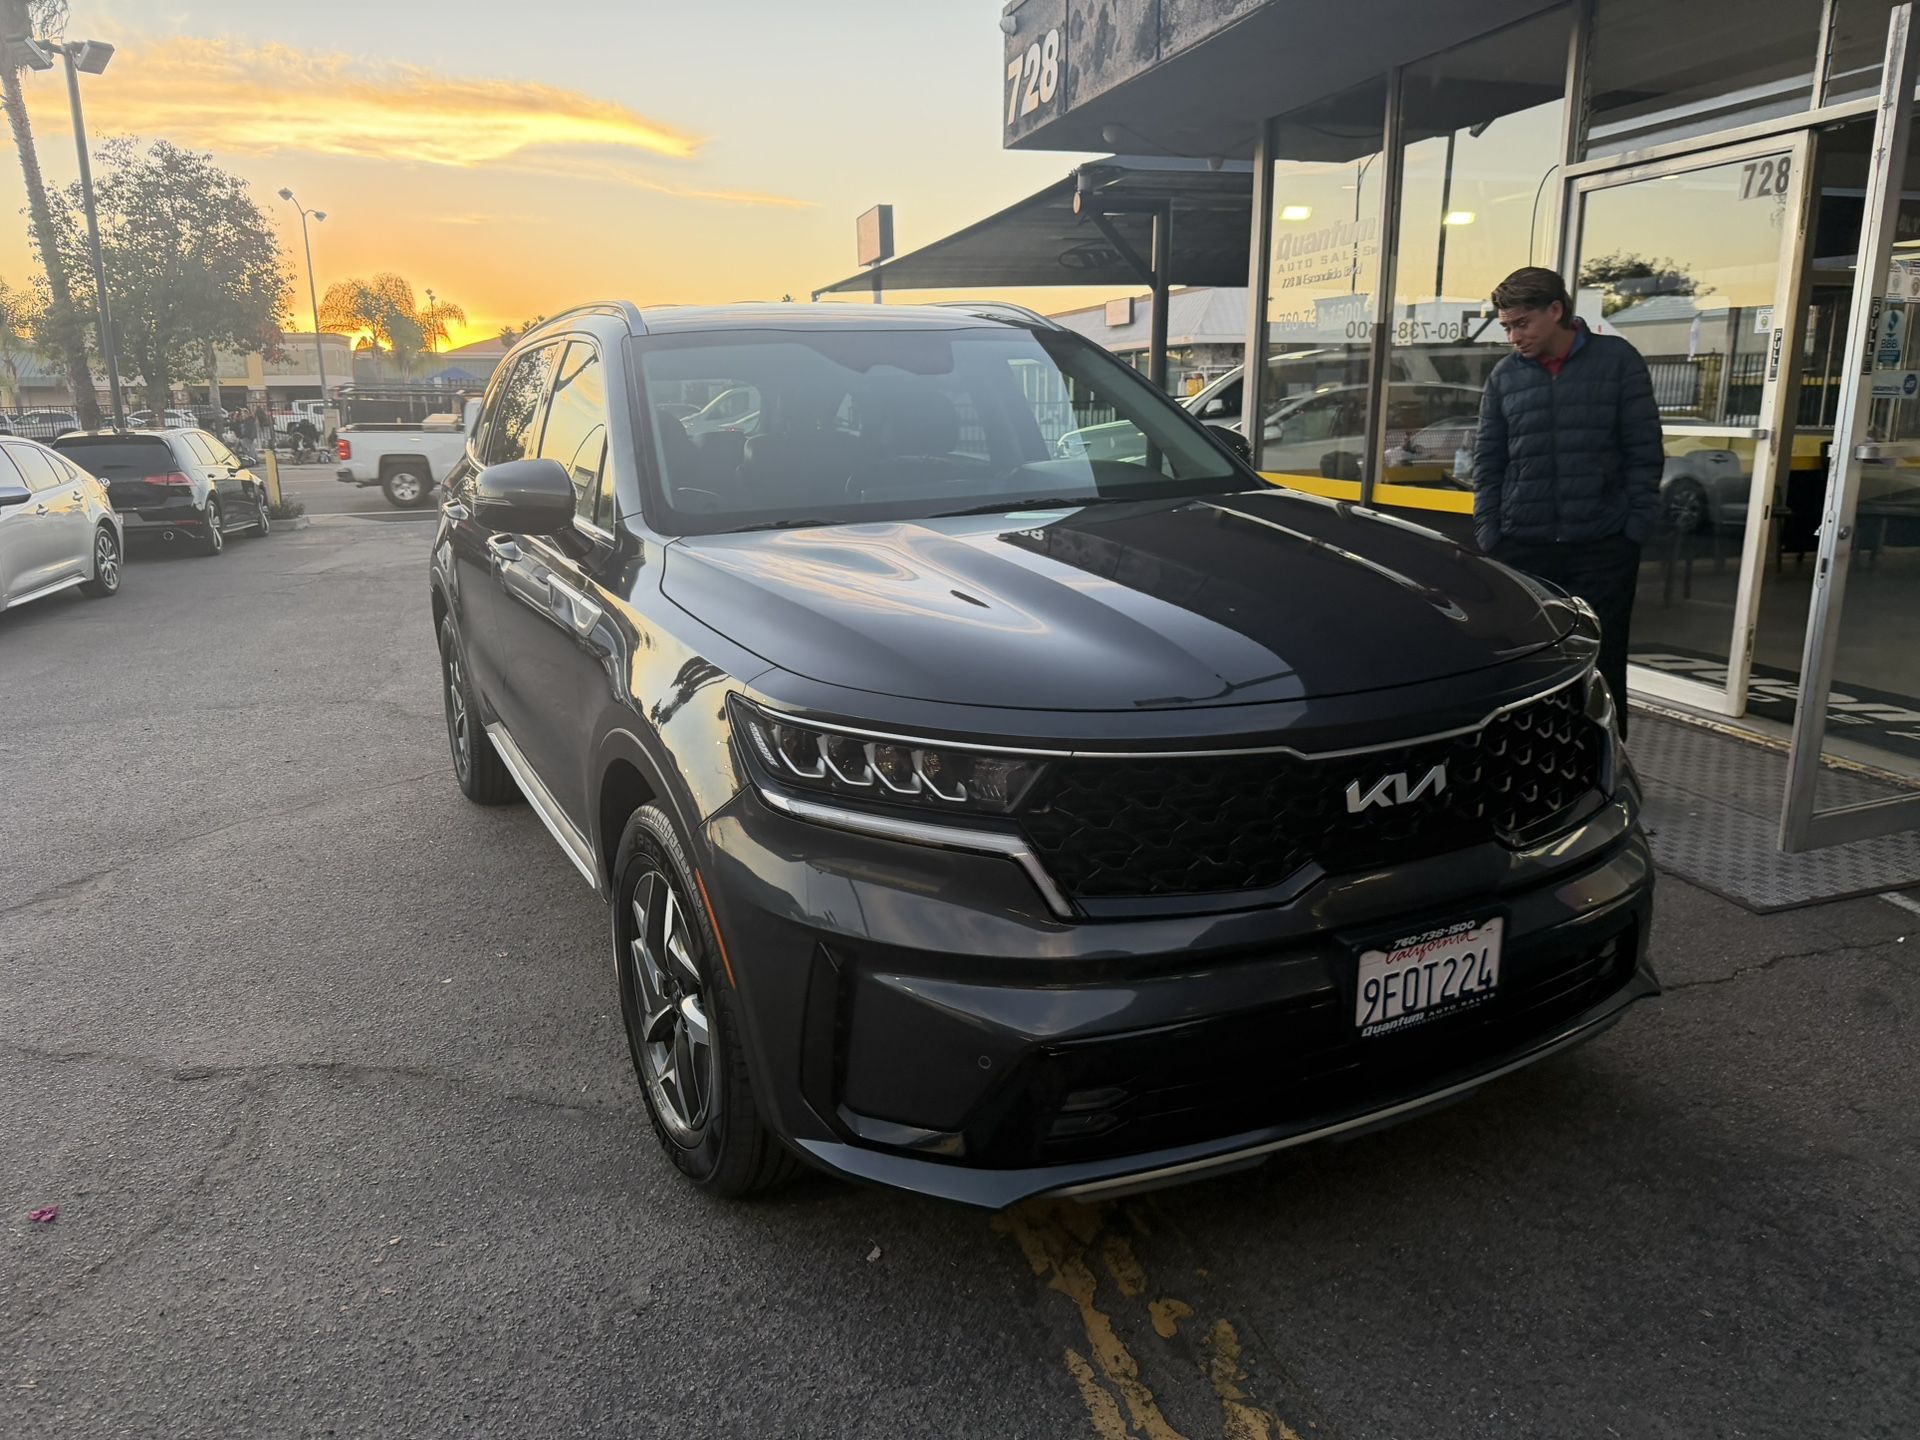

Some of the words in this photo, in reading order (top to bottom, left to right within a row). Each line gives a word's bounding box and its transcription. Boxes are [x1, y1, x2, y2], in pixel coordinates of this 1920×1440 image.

[1007, 29, 1059, 126] 728
[1743, 156, 1792, 199] 728
[1276, 216, 1377, 261] Quantum
[1277, 257, 1313, 274] AUTO
[1278, 301, 1361, 333] 760-738-1500
[1866, 304, 1881, 356] PULL
[1770, 331, 1783, 368] PULL
[1345, 763, 1448, 814] KIA
[1385, 931, 1479, 964] California
[1391, 919, 1476, 950] 760-738-1500
[1362, 947, 1492, 1024] 9FOT224
[1361, 1011, 1425, 1038] Quantum
[1427, 1003, 1457, 1018] AUTO
[1460, 992, 1496, 1007] SALES
